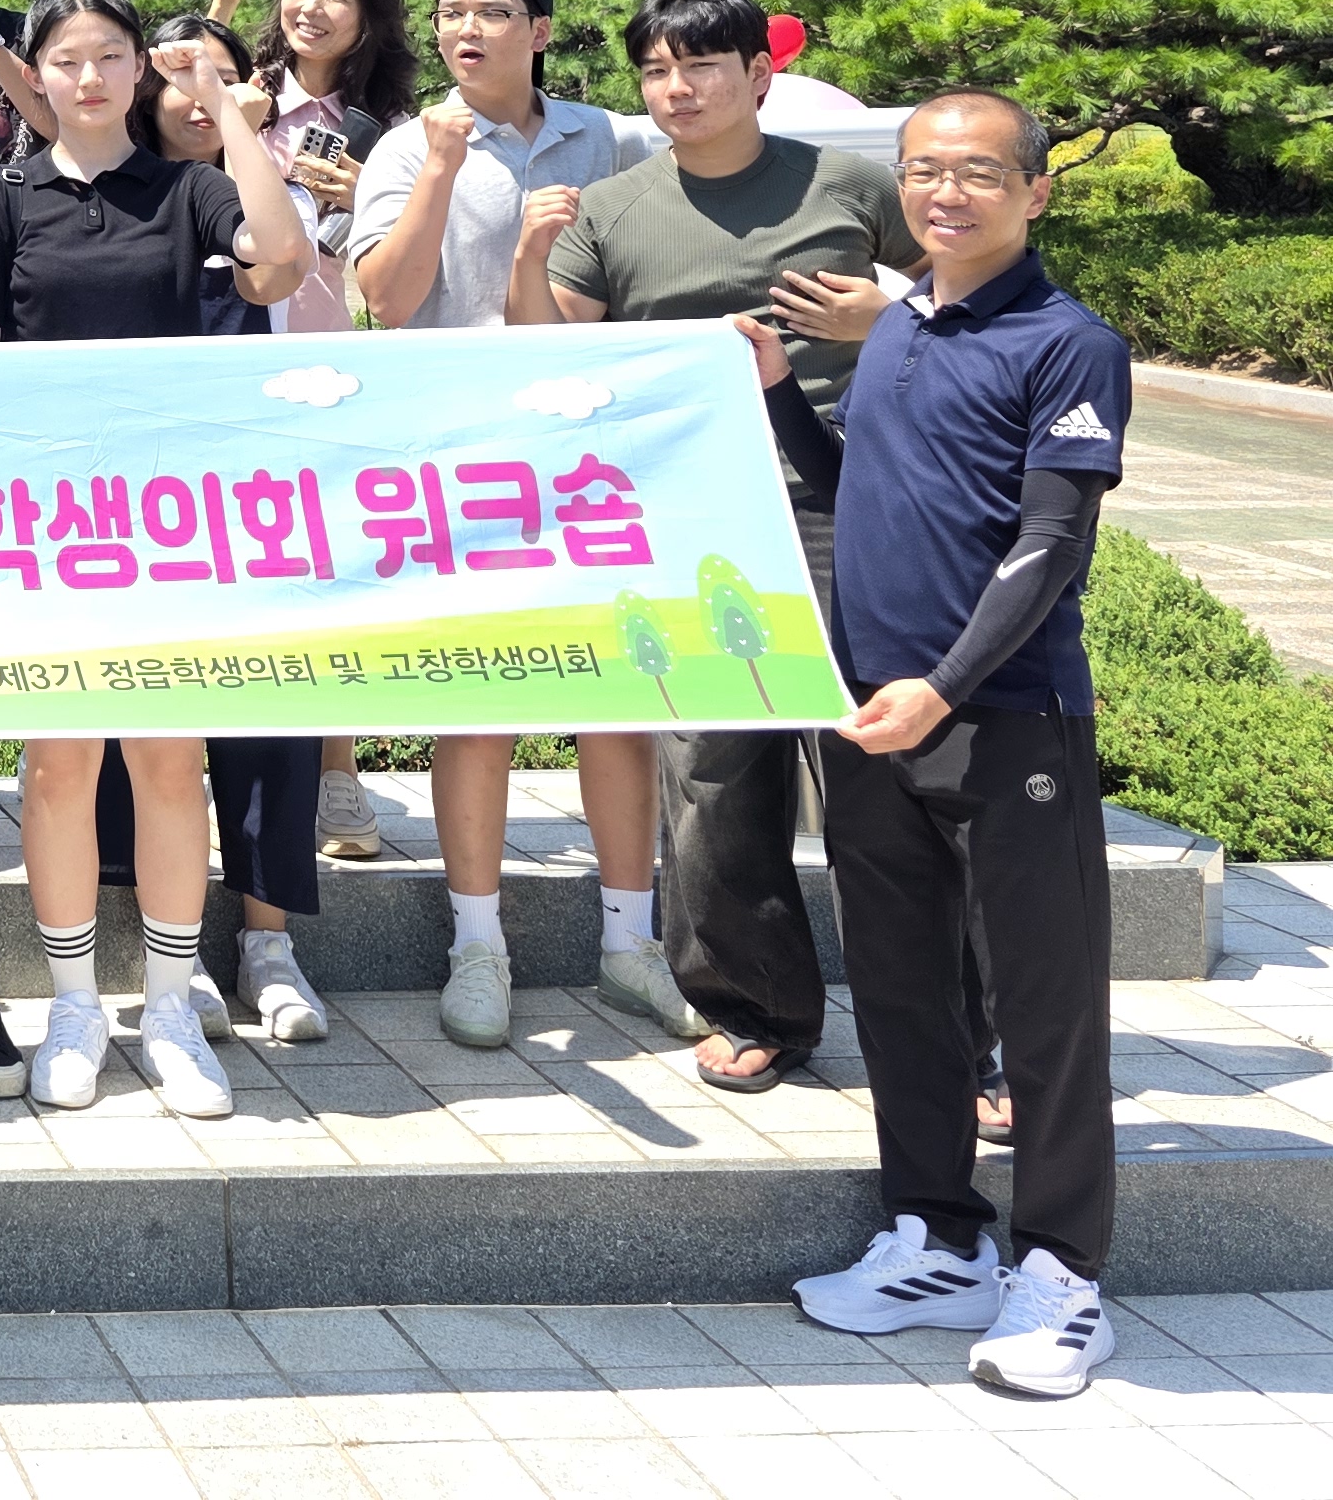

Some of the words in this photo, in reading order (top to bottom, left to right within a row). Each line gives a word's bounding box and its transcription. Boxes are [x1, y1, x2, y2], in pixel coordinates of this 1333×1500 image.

[1049, 424, 1111, 440] adidas
[355, 452, 654, 579] 워크숍
[100, 652, 319, 691] 정읍학생의회
[328, 651, 369, 685] 및
[380, 642, 602, 682] 고창학생의회
